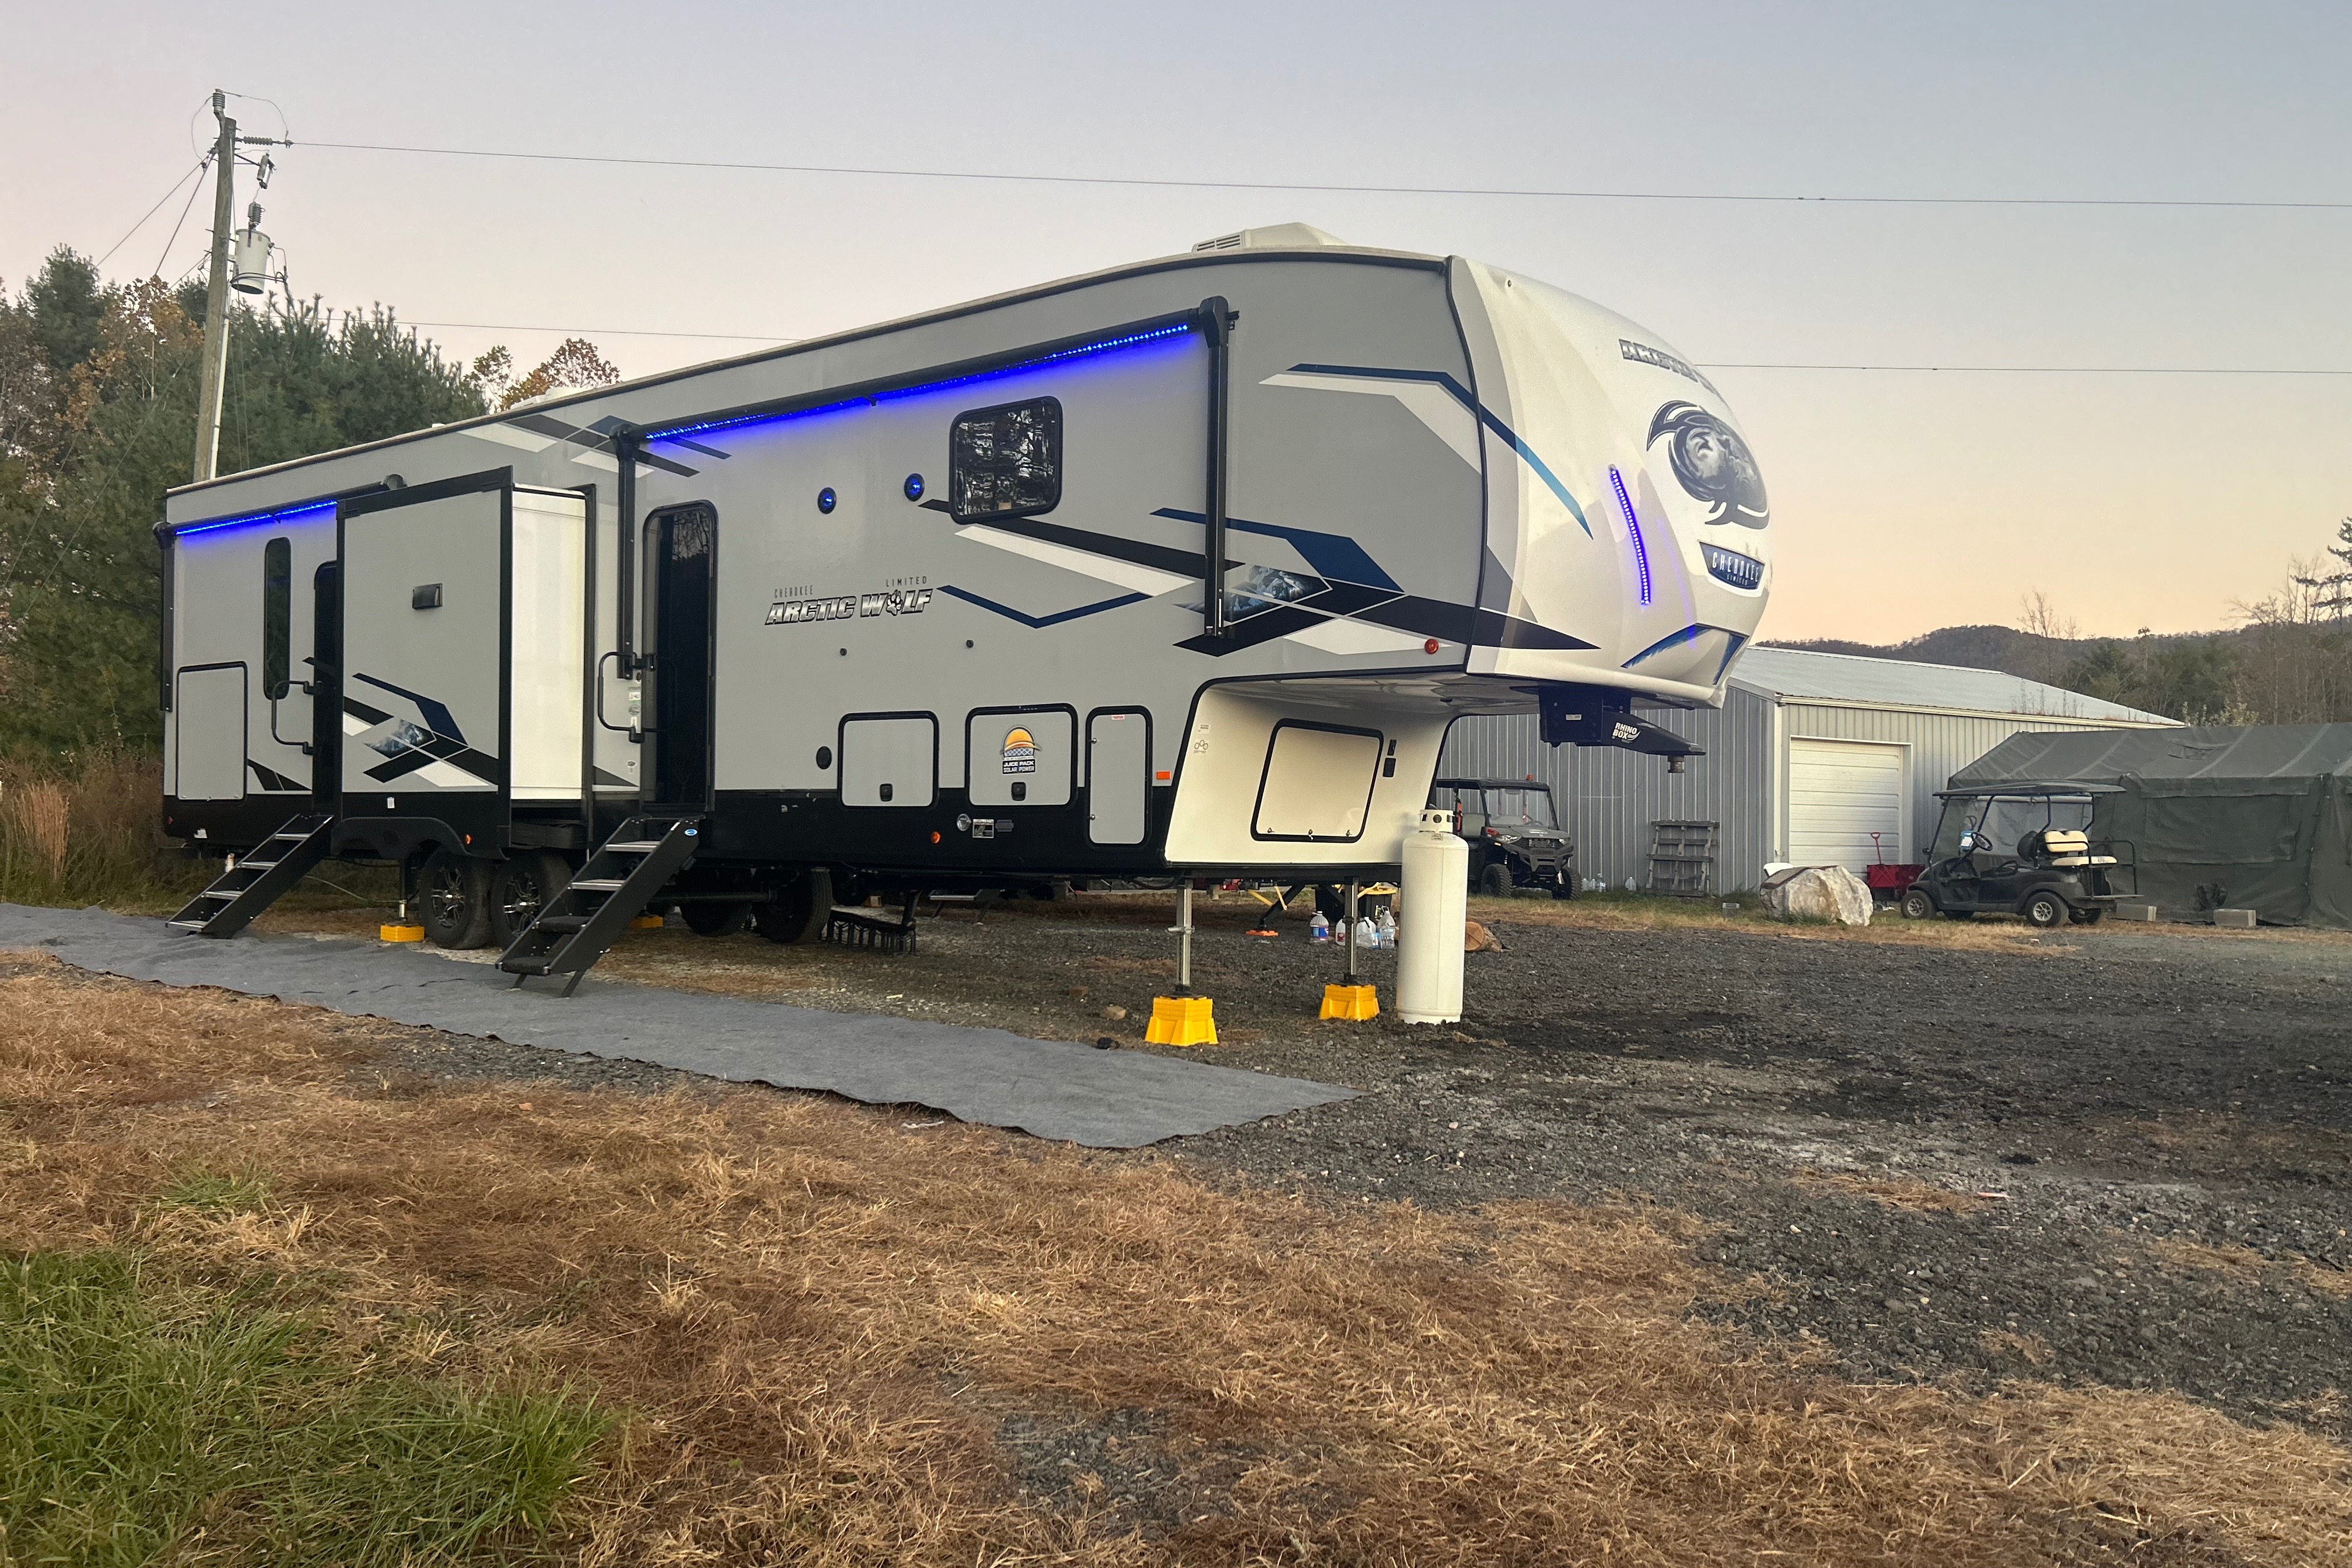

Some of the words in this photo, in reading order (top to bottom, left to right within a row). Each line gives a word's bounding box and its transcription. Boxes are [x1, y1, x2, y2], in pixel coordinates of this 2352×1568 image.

[1712, 552, 1759, 582] CHEROKEE
[886, 576, 927, 587] LIMITED
[775, 585, 813, 598] CHEROKEE
[765, 596, 856, 625] ARCTIC
[860, 589, 933, 617] WLF
[1612, 729, 1629, 739] BOX
[1615, 722, 1637, 734] RHINO
